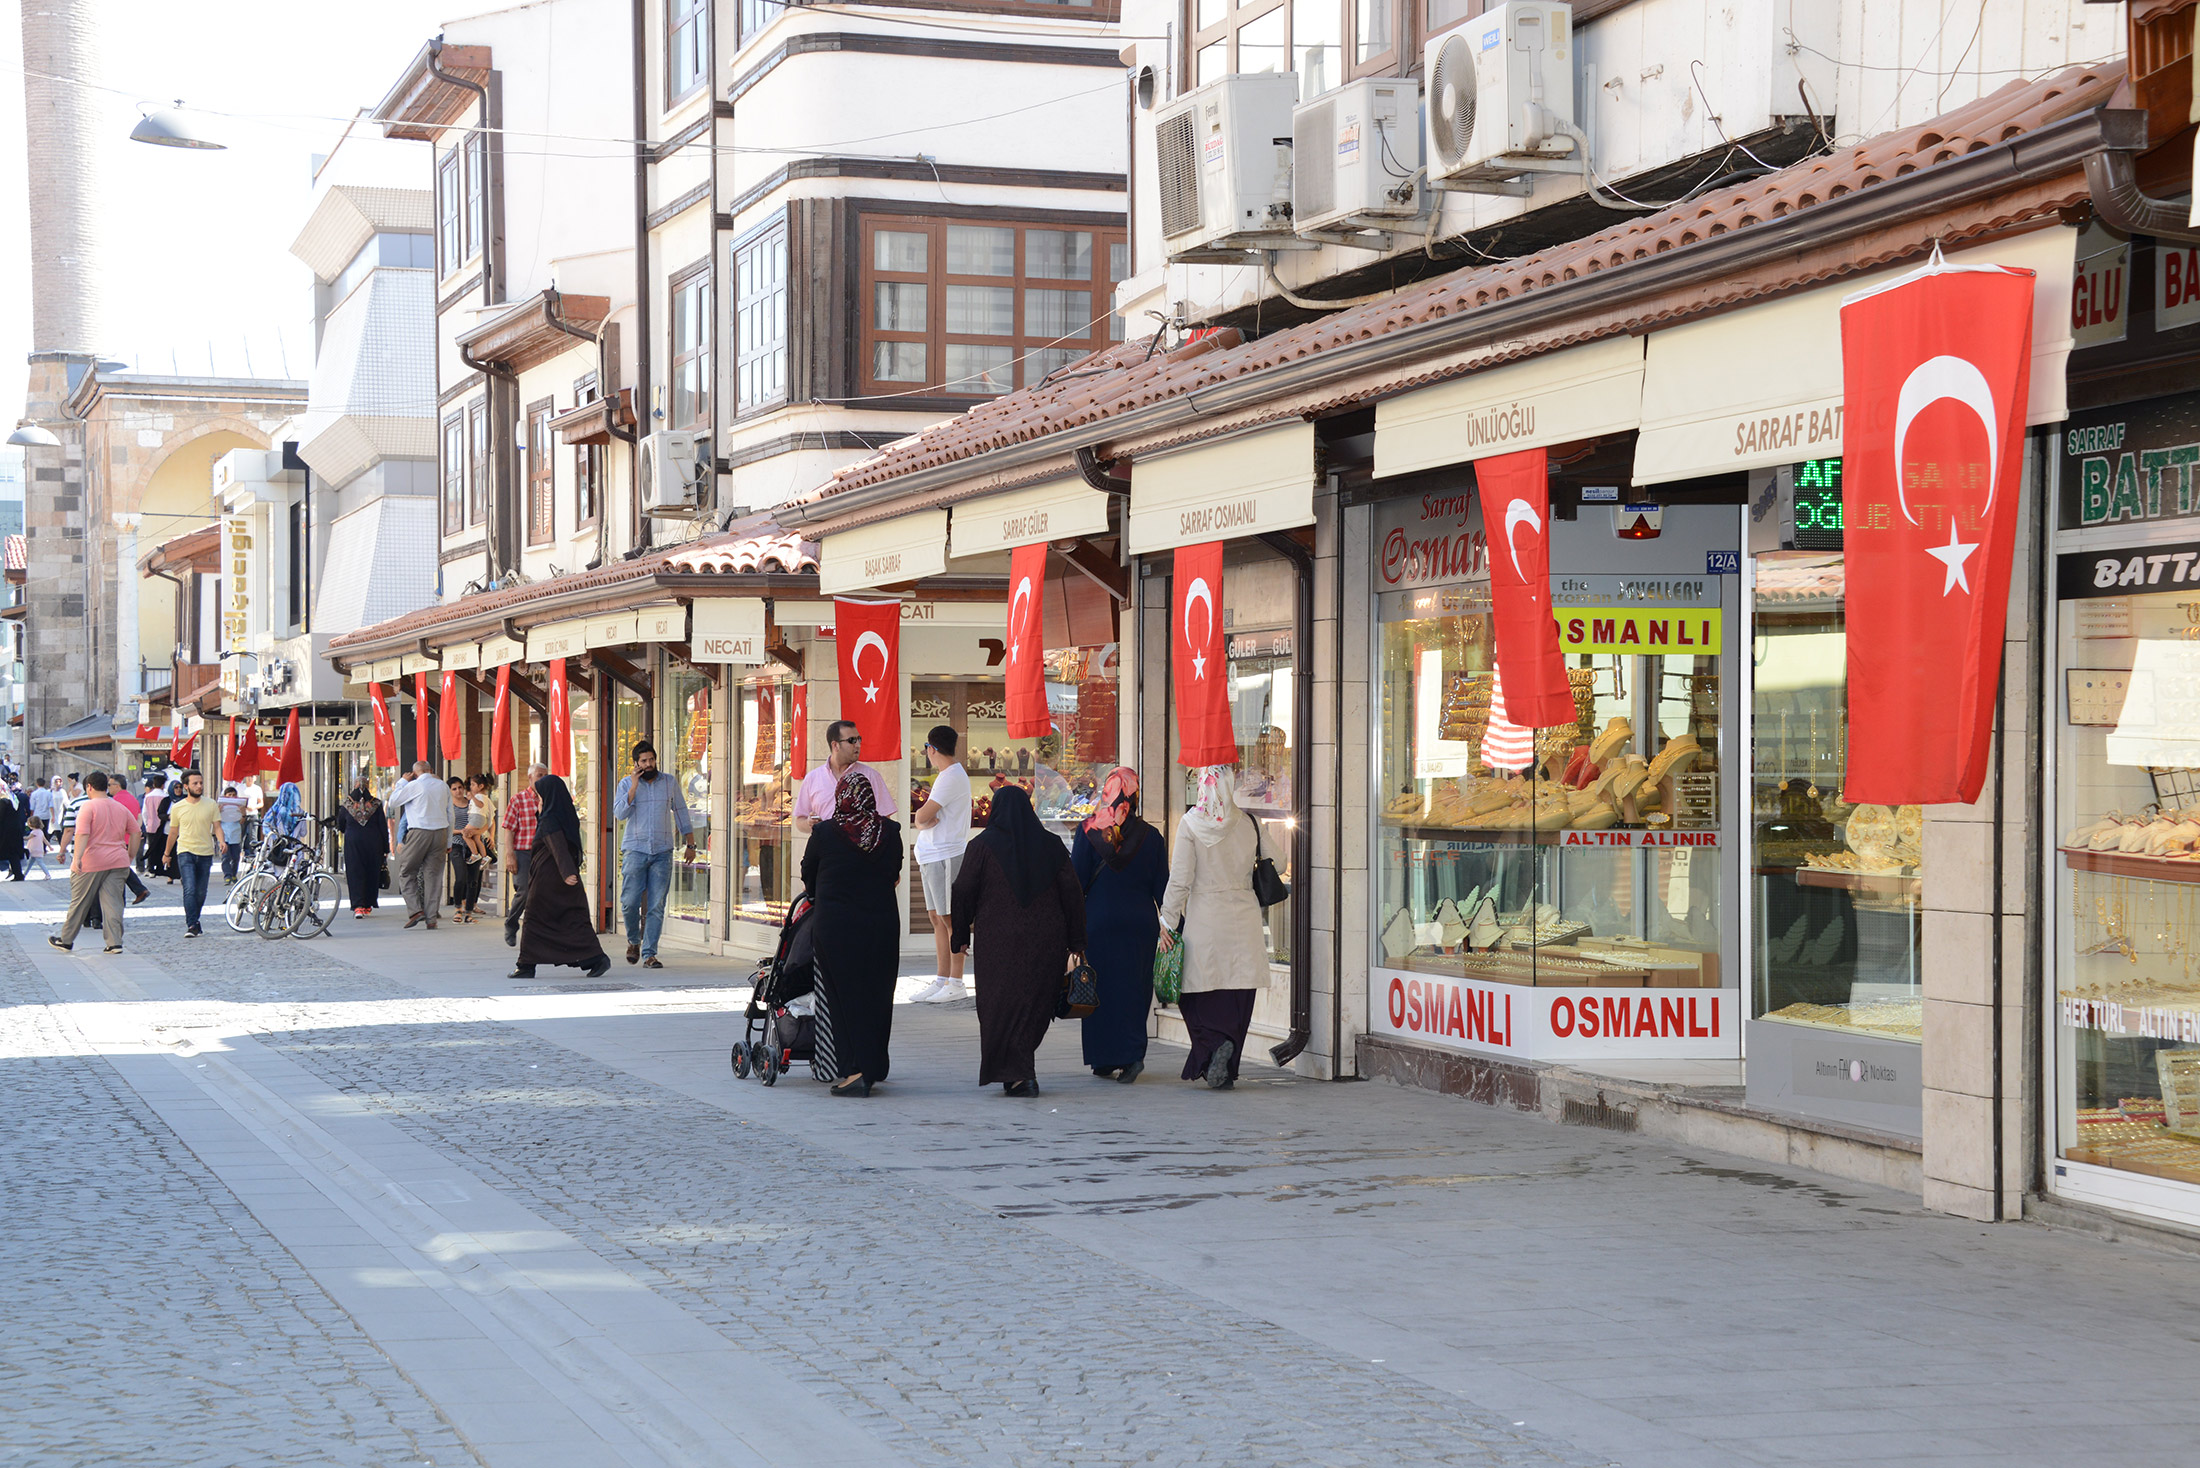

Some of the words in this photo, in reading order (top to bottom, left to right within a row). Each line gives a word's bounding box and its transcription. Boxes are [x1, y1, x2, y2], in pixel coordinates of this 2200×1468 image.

[1467, 402, 1535, 447] ÜNLÜOĞLU
[1734, 412, 1804, 456] SARRAF
[2067, 422, 2126, 456] SARRAF
[1794, 459, 1842, 487] AF
[2081, 442, 2200, 526] BATT
[1180, 508, 1213, 536] SARRAF
[1214, 499, 1257, 531] OSMANLI
[1421, 486, 1474, 528] Sarraf
[1003, 516, 1027, 540] SARRAF
[1028, 510, 1049, 535] GÜLER
[865, 557, 881, 580] BAŞAK
[881, 553, 901, 575] SARRAF
[1708, 554, 1737, 568] 12/A
[2093, 551, 2200, 588] BATT
[1561, 579, 1589, 591] the
[704, 638, 752, 656] NECATİ
[1228, 638, 1257, 659] GÜLER
[1272, 636, 1293, 656] GÜL
[1566, 832, 1631, 846] ALTIN
[1641, 832, 1717, 846] ALINIR
[1388, 977, 1512, 1047] OSMANLI
[1549, 996, 1720, 1039] OSMANLI
[2063, 996, 2089, 1029] HER
[2139, 1006, 2178, 1041] ALTIN
[1870, 1064, 1897, 1082] Noktası
